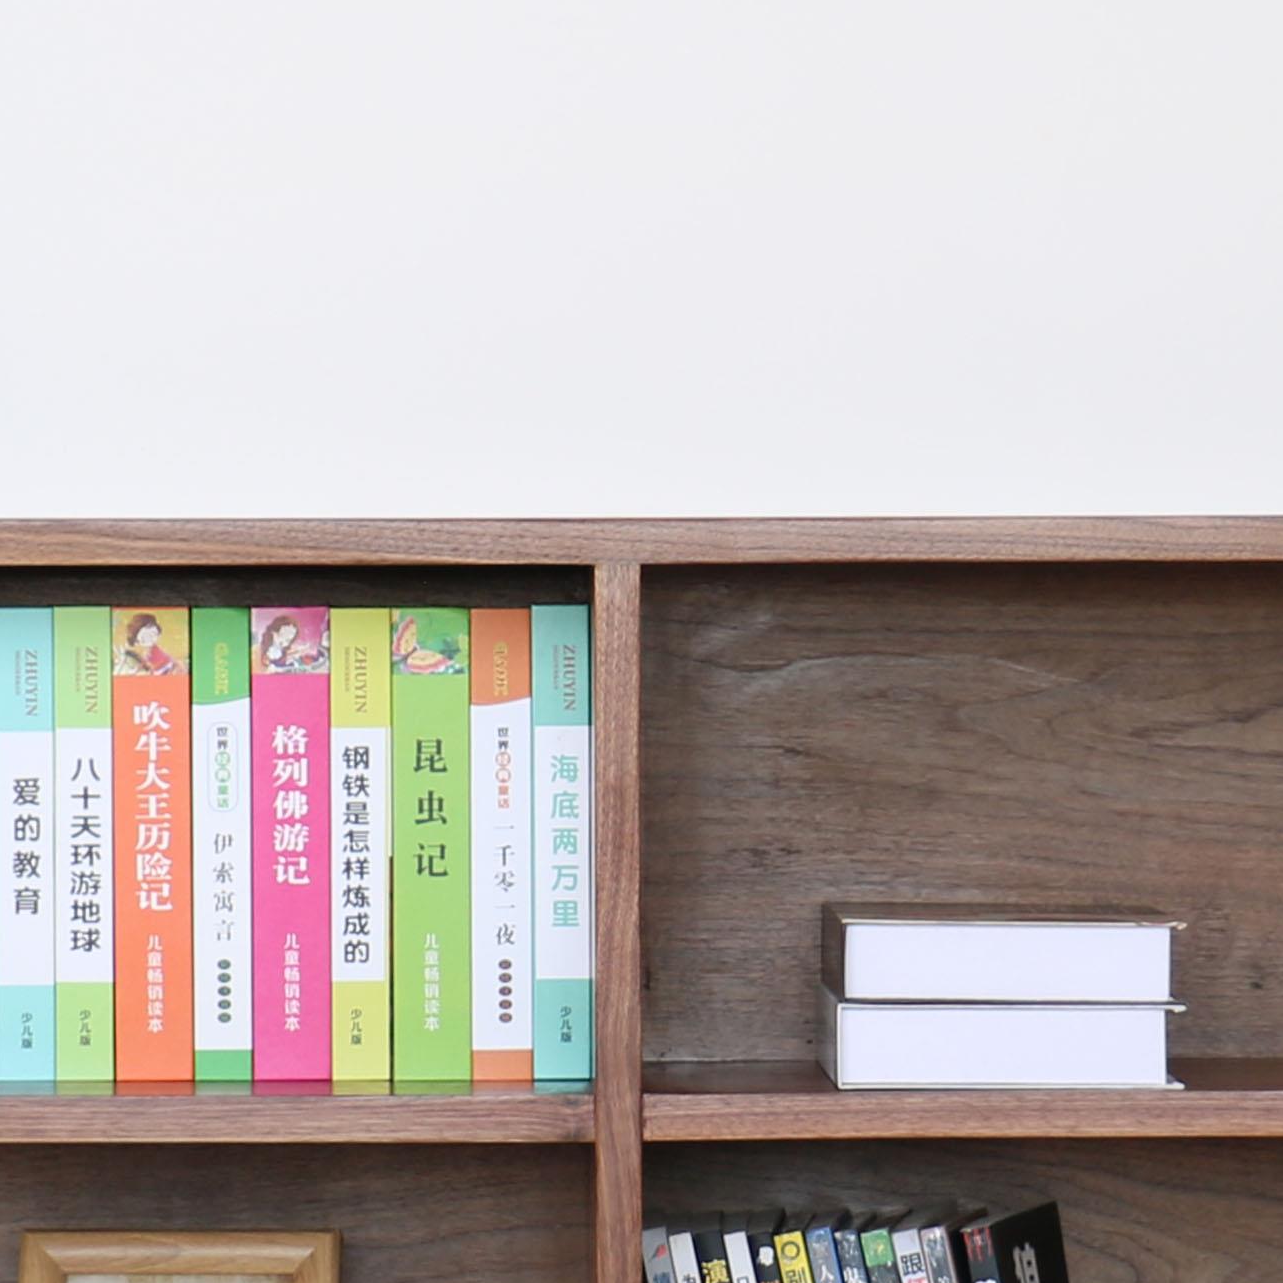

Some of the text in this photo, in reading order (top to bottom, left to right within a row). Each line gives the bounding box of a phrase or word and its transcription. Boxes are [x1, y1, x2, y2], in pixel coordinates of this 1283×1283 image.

[24, 649, 38, 717] ZHUYIN
[85, 646, 98, 714] ZHUYIN
[354, 646, 368, 714] ZHUYIN
[562, 645, 577, 711] ZHUYIN
[12, 777, 41, 915] 爱的教育
[133, 701, 173, 912] 吹牛大王历险记
[271, 724, 310, 885] 格列佛游记
[413, 738, 448, 879] 昆虫记
[550, 754, 579, 928] 海底两万里
[70, 757, 101, 953] 八十天环游地球
[213, 831, 235, 942] 伊索寓言
[341, 745, 370, 965] 钢铁是怎样炼成的
[493, 825, 516, 945] 一千零一夜
[20, 1011, 34, 1050] 少儿版
[79, 1008, 92, 1047] 少儿版
[146, 933, 163, 1034] 儿童畅销读本
[283, 932, 300, 1031] 儿童畅销读本
[350, 1007, 363, 1046] 少儿版
[423, 932, 440, 1031] 儿童畅销读本
[560, 1006, 573, 1044] 少儿版
